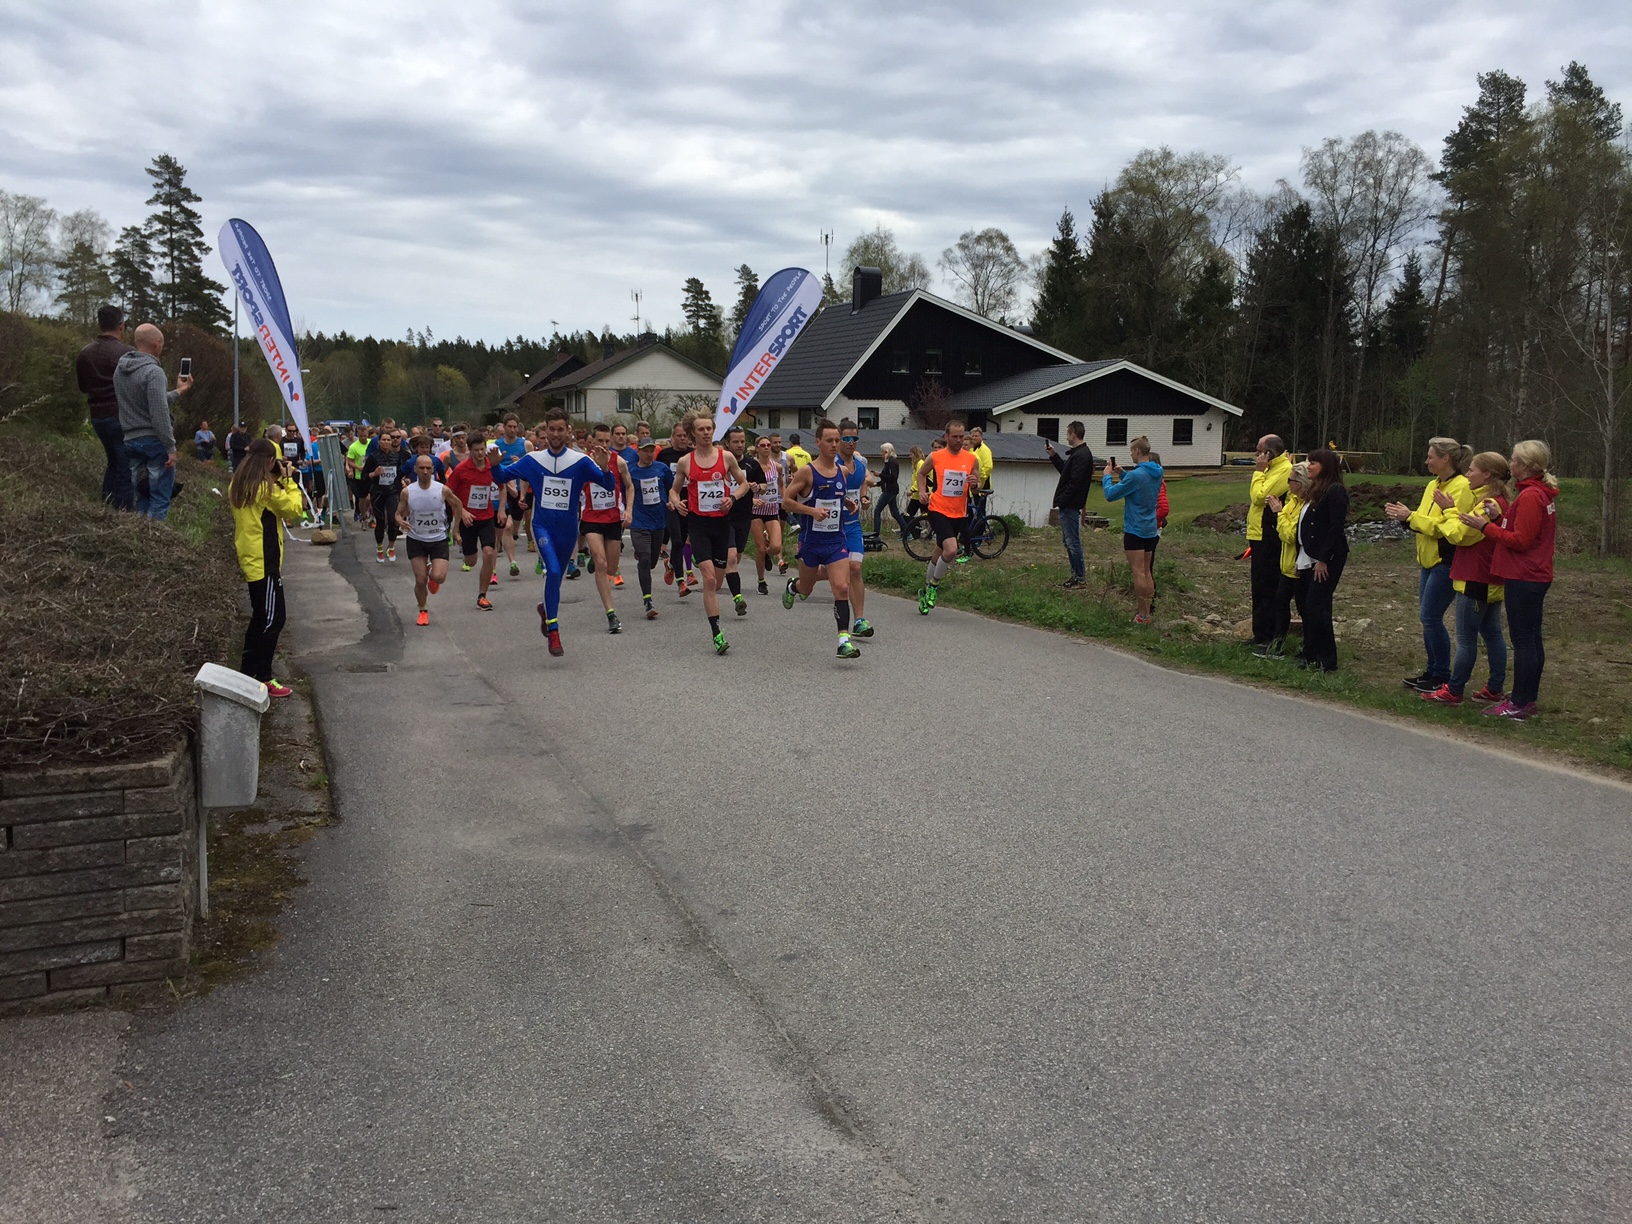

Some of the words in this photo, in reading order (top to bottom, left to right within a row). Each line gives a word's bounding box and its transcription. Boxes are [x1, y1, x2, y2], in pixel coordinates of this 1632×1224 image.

[758, 312, 772, 332] SPORT
[771, 303, 779, 313] TO
[786, 271, 803, 292] PEOPLE
[735, 305, 808, 401] INTERSPORT
[945, 478, 964, 487] 731
[543, 486, 569, 498] 593
[592, 490, 614, 499] 739
[642, 485, 659, 495] 549
[699, 490, 723, 499] 742
